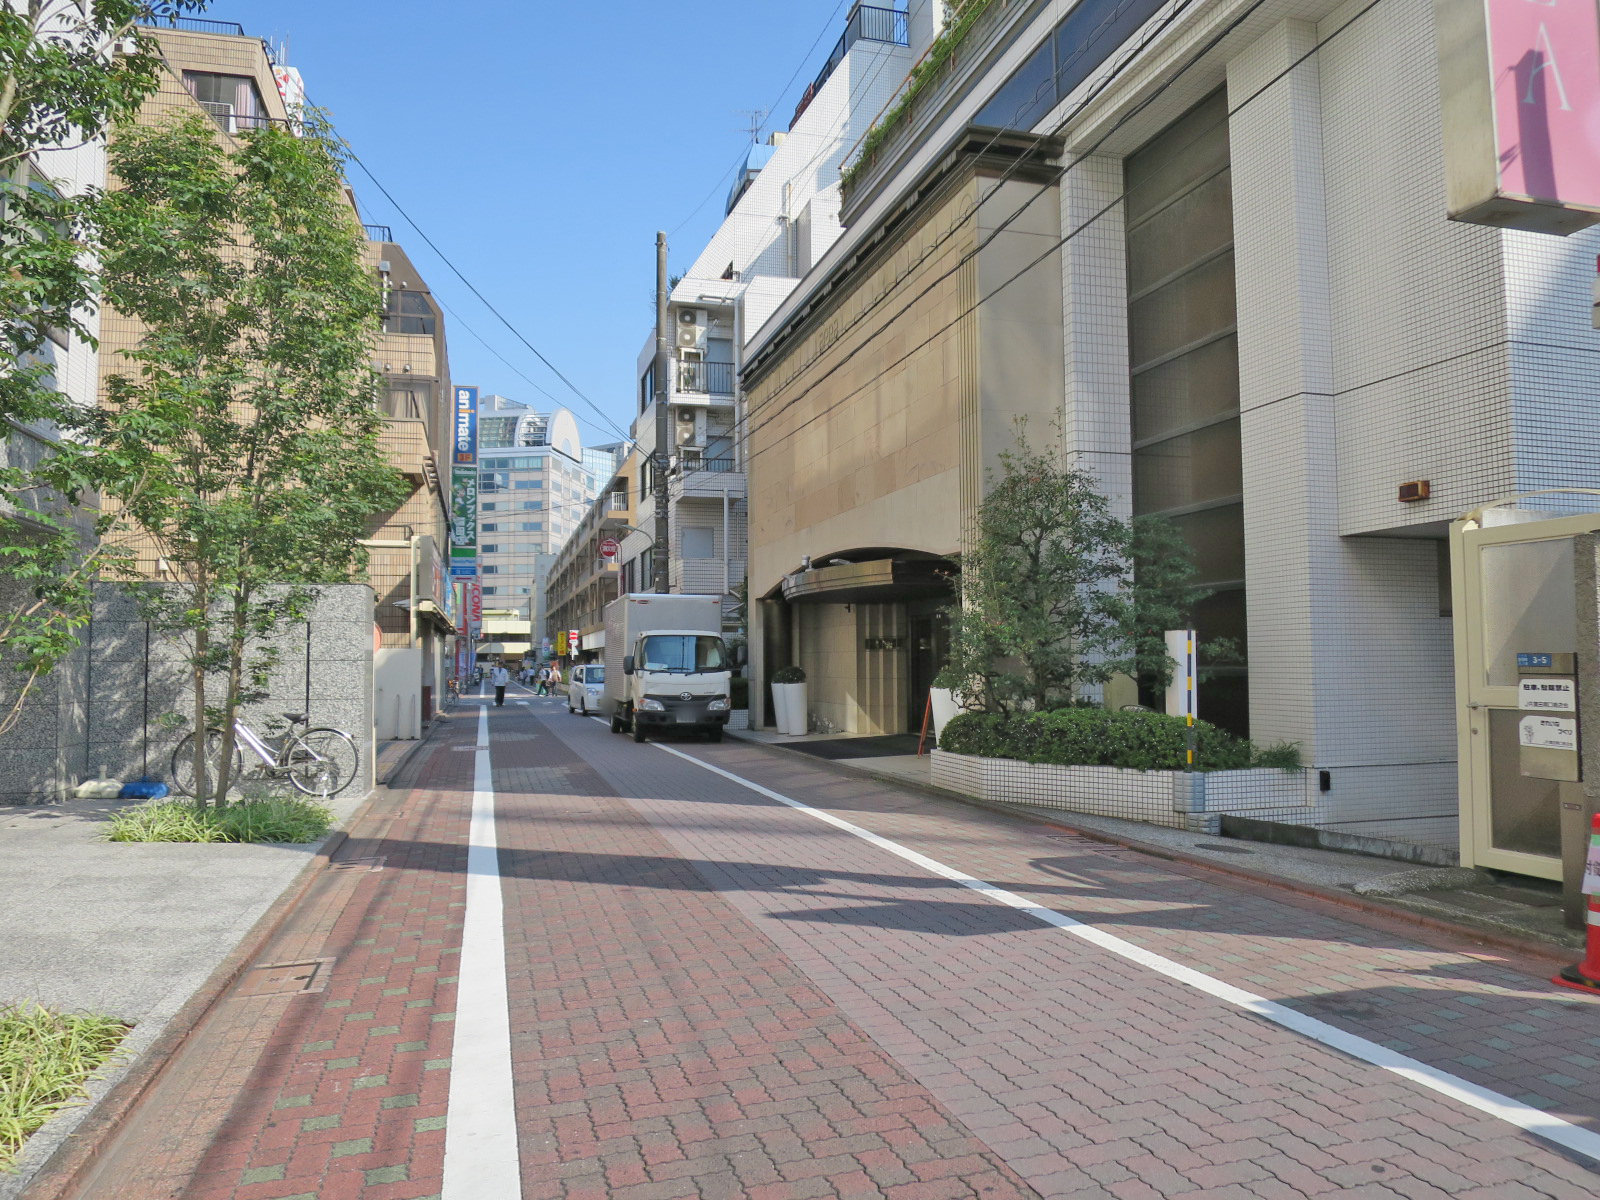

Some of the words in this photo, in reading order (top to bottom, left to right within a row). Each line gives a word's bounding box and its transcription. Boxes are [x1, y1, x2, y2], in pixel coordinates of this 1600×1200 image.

[458, 389, 475, 451] animate
[466, 478, 476, 540] メロンブックス
[1532, 656, 1547, 664] 3-5
